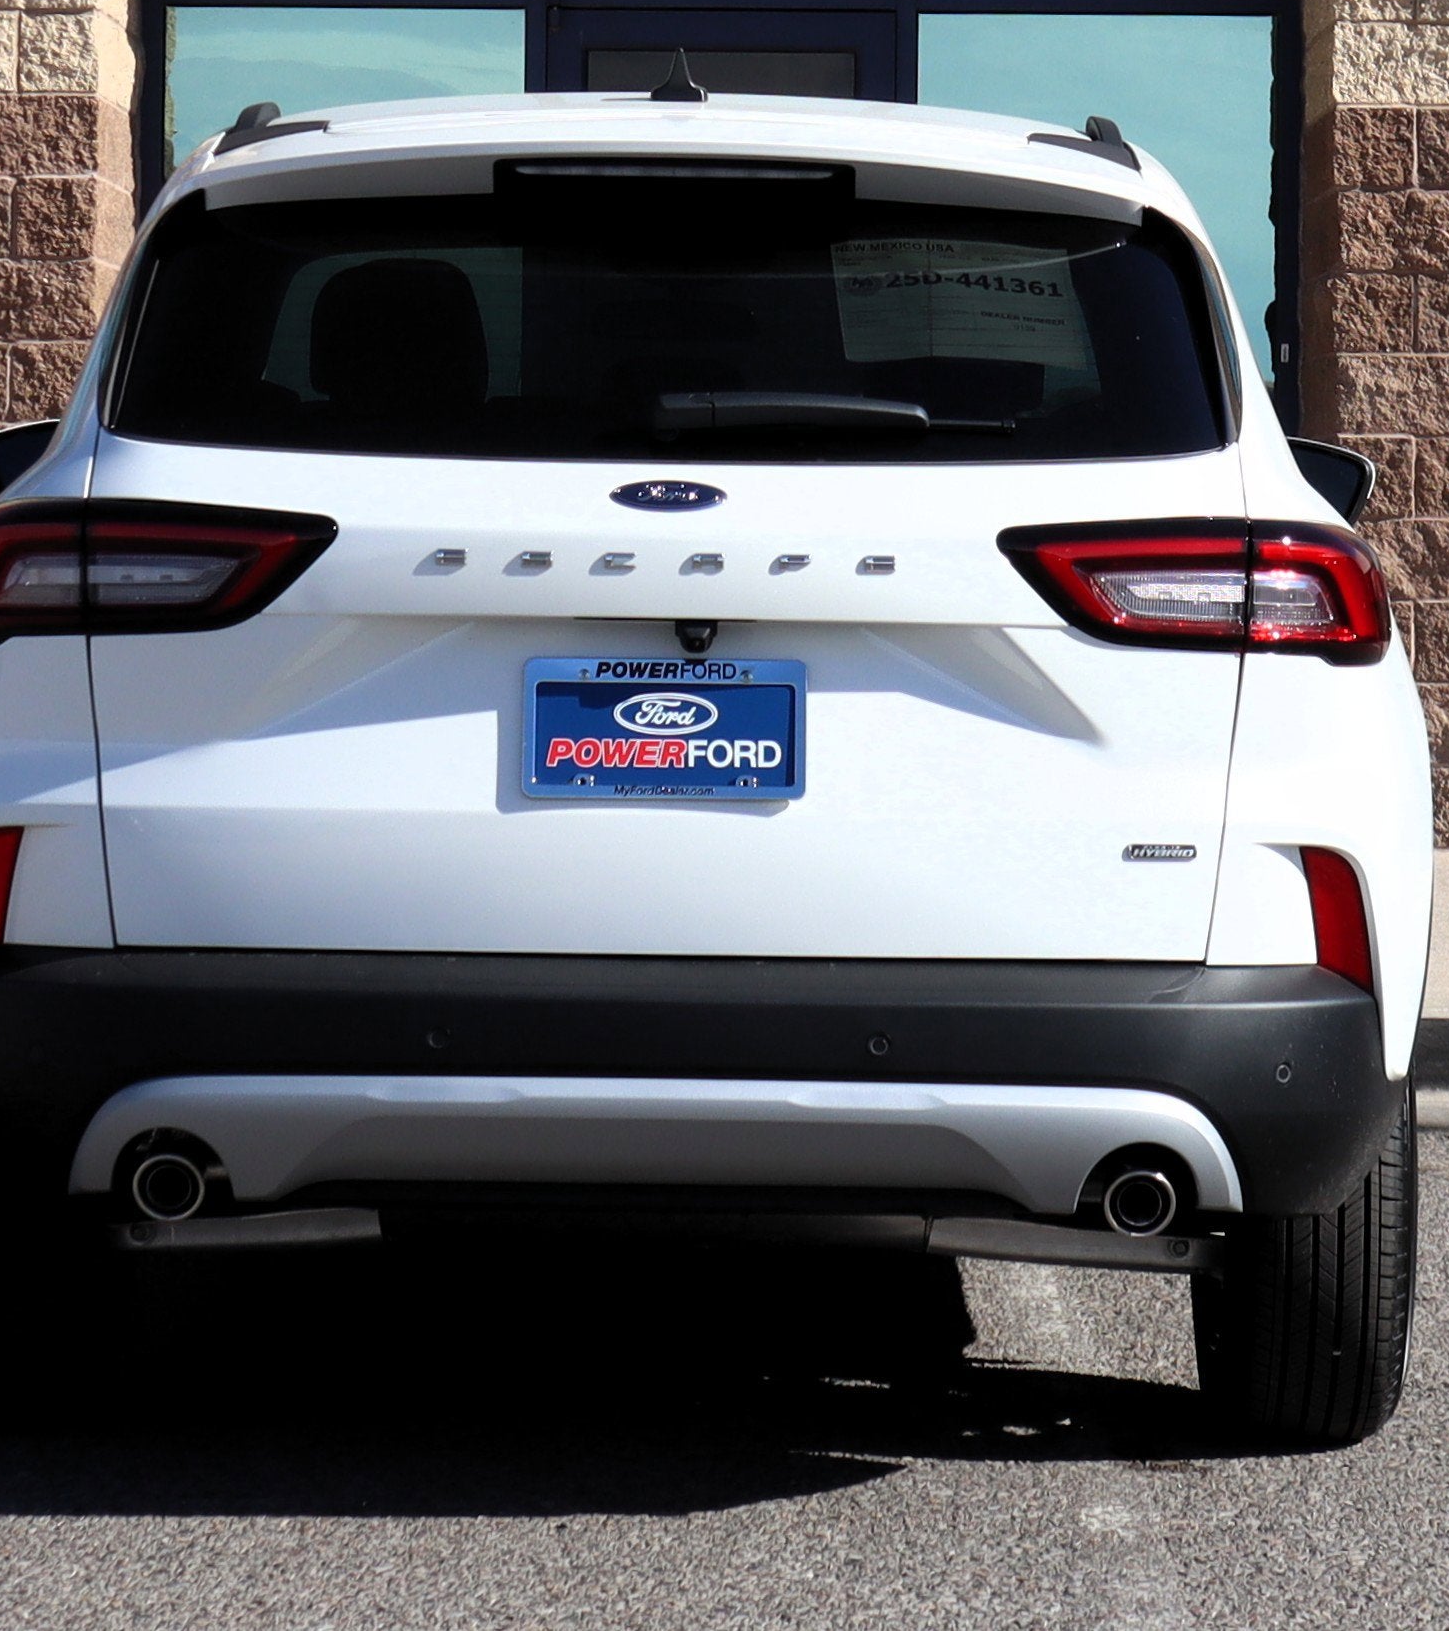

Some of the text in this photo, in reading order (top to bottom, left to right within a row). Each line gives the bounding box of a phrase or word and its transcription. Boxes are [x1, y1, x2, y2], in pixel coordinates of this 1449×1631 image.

[836, 242, 954, 253] NEW MEXICO USA
[435, 548, 895, 573] ESCAPE
[595, 661, 737, 680] POWERFORD
[634, 699, 696, 726] Ford
[546, 737, 782, 769] POWERFORD
